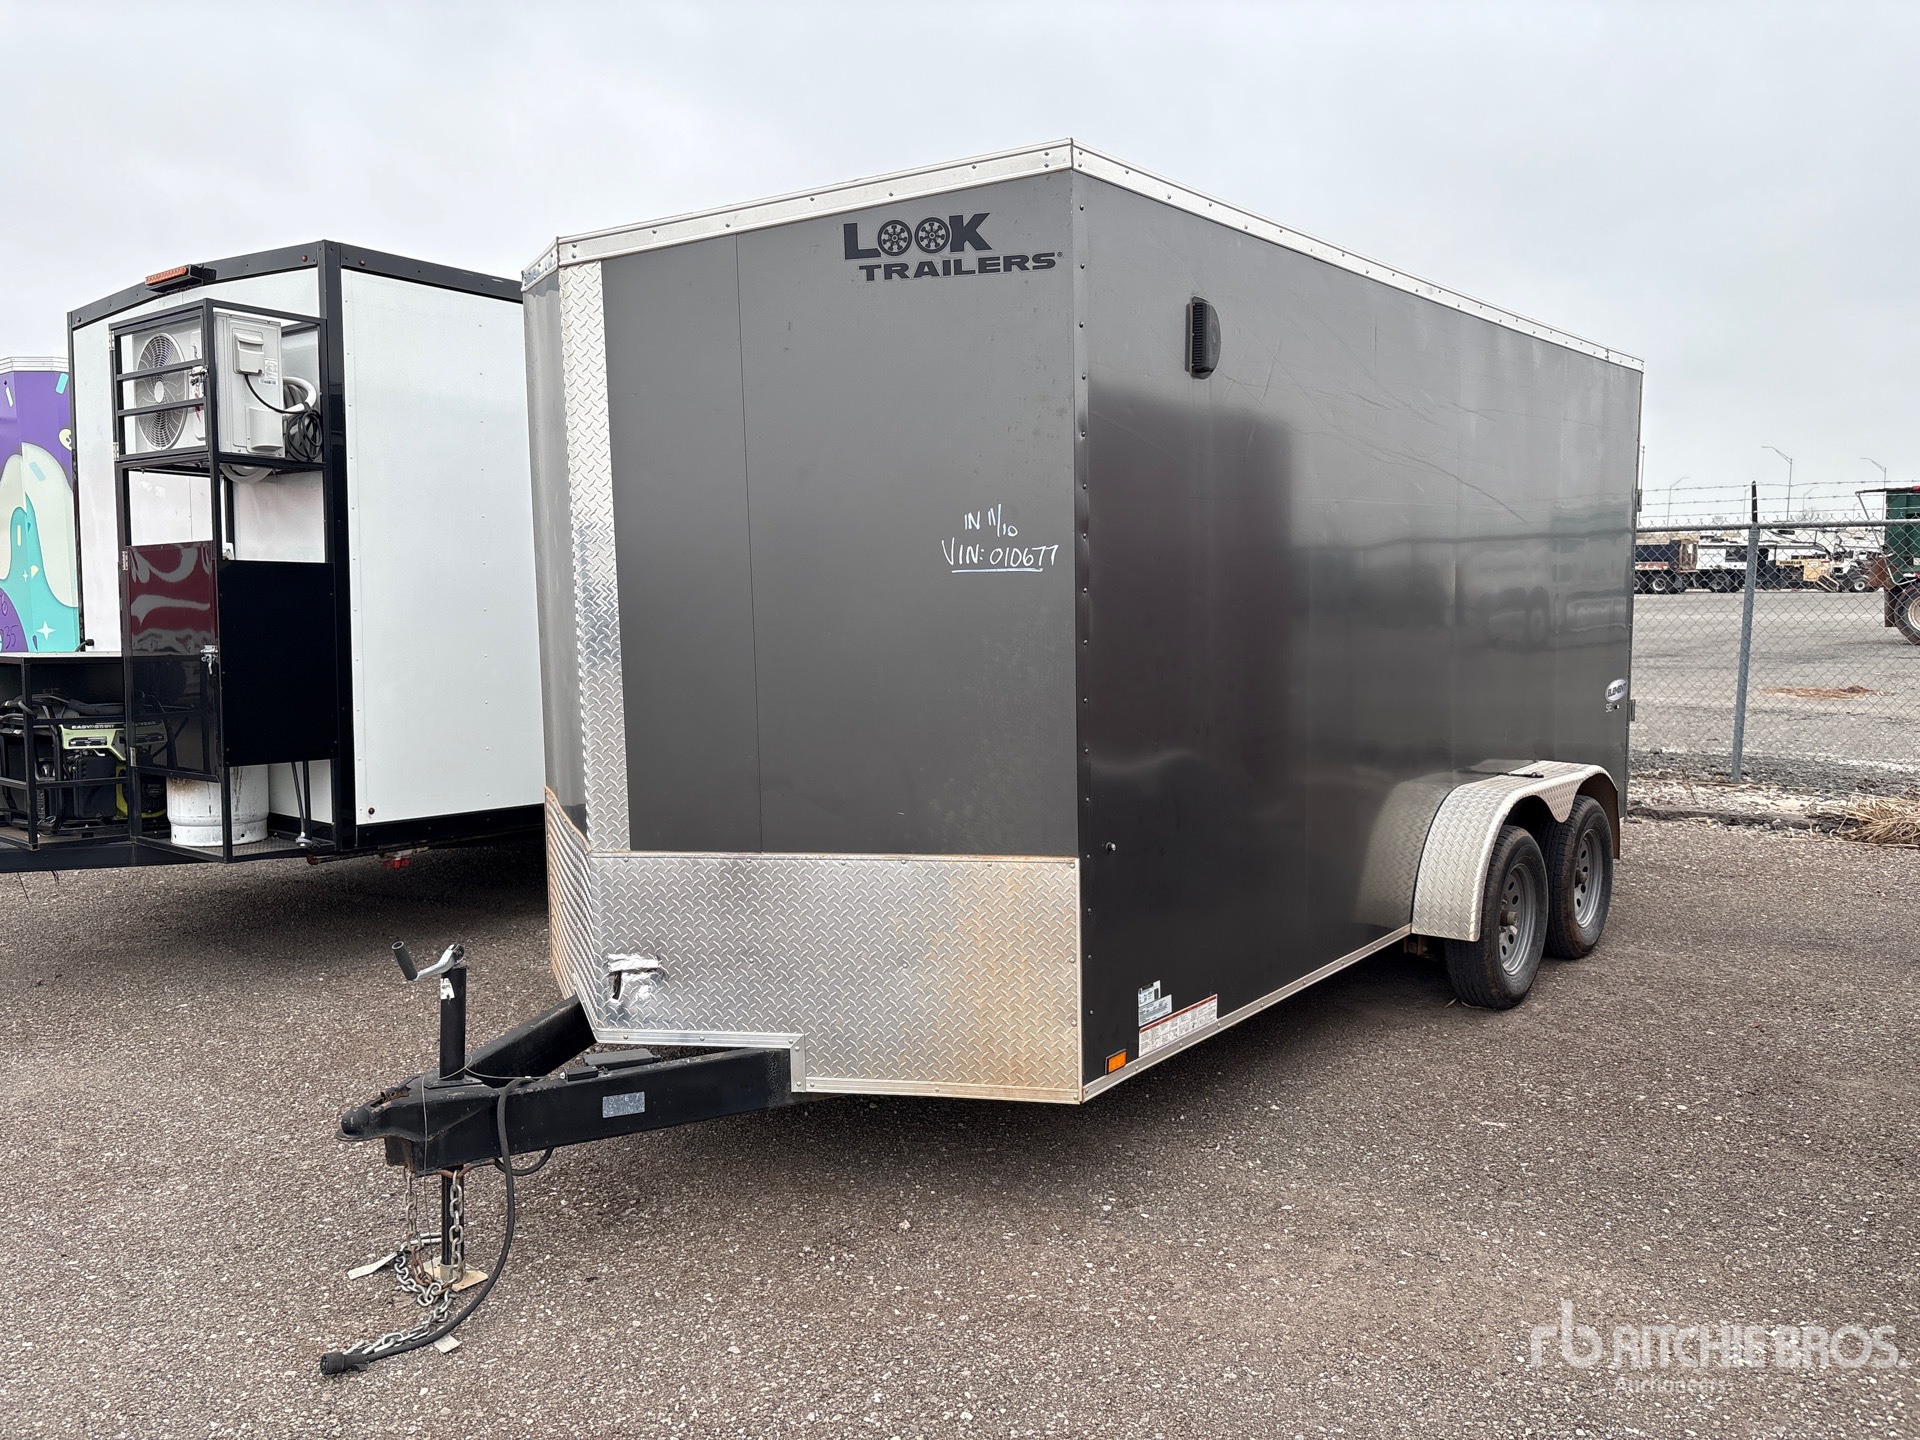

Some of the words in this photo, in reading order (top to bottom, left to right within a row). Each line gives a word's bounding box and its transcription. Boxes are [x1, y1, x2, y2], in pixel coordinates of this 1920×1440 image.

[843, 212, 993, 260] LOOK
[859, 253, 1056, 281] TRAILERS
[965, 511, 980, 530] IN
[988, 504, 1018, 537] 11/10
[942, 537, 985, 566] VIN:
[990, 544, 1059, 567] 010677
